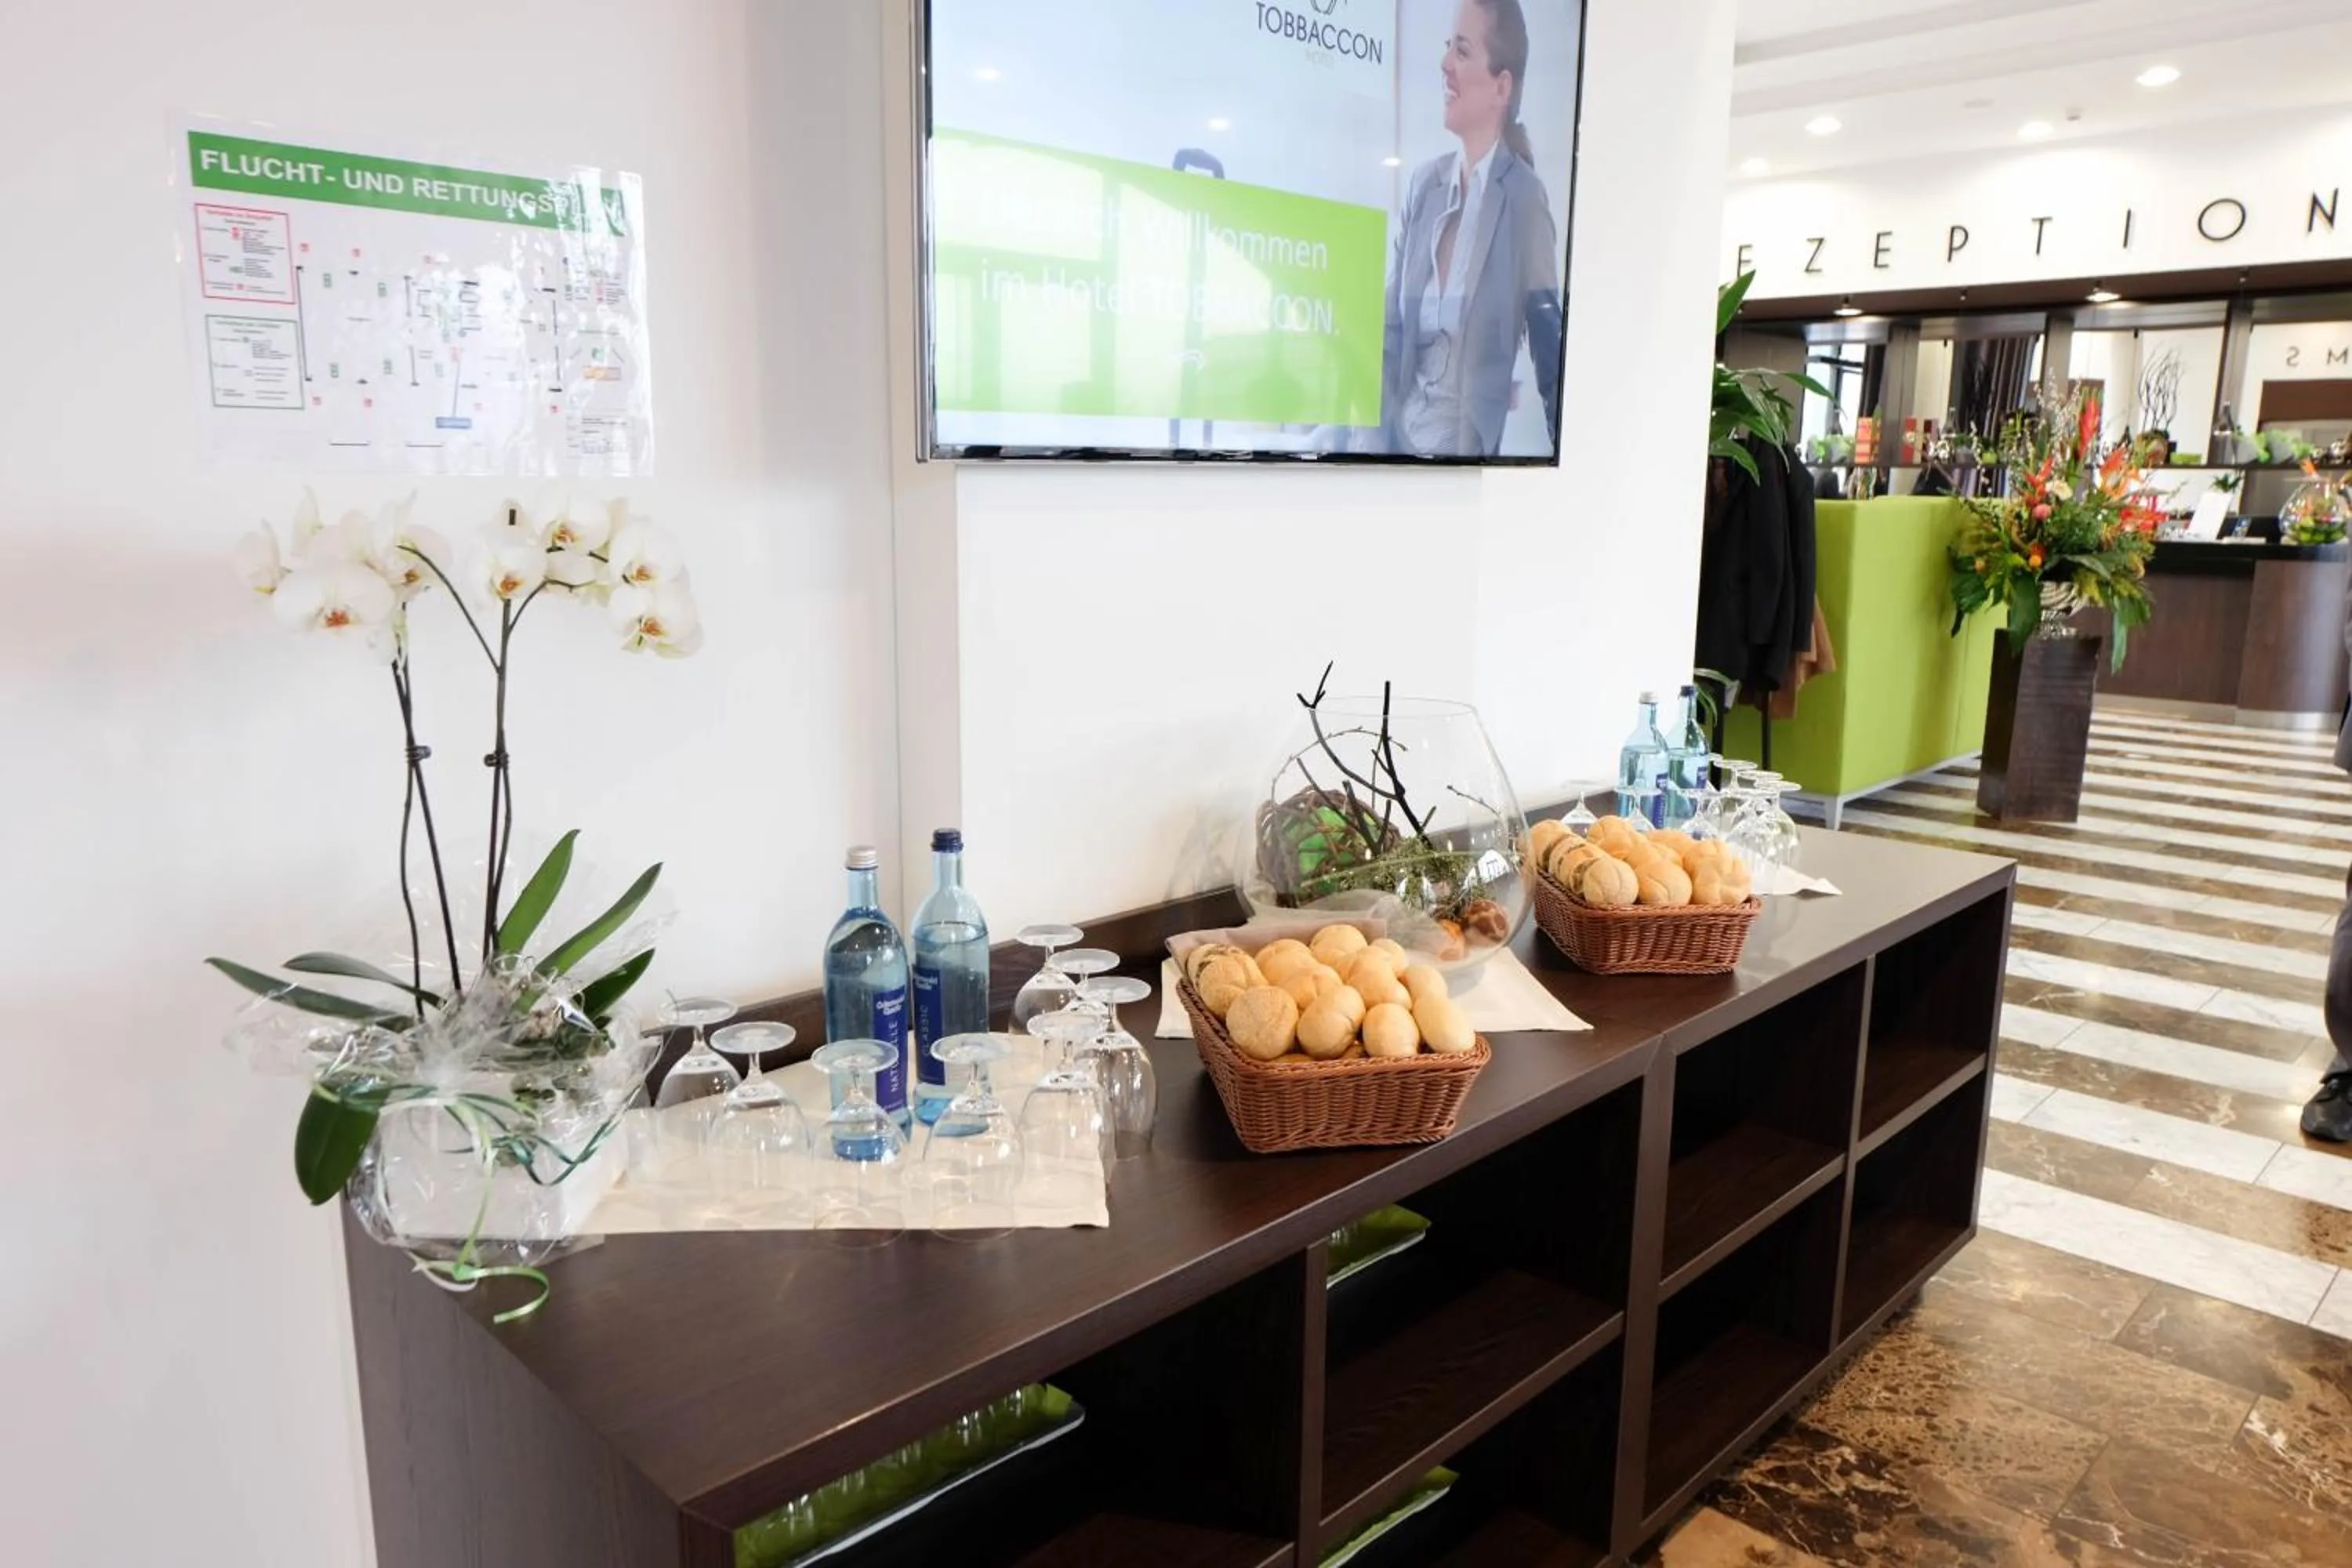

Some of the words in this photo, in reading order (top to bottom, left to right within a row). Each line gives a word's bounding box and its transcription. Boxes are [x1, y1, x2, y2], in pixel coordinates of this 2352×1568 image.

[1255, 1, 1383, 65] TOBBACCON
[199, 148, 337, 185] FLUCHT-
[342, 167, 405, 194] UND
[411, 176, 625, 225] RETTUNGSP
[888, 1020, 899, 1093] NATULLE
